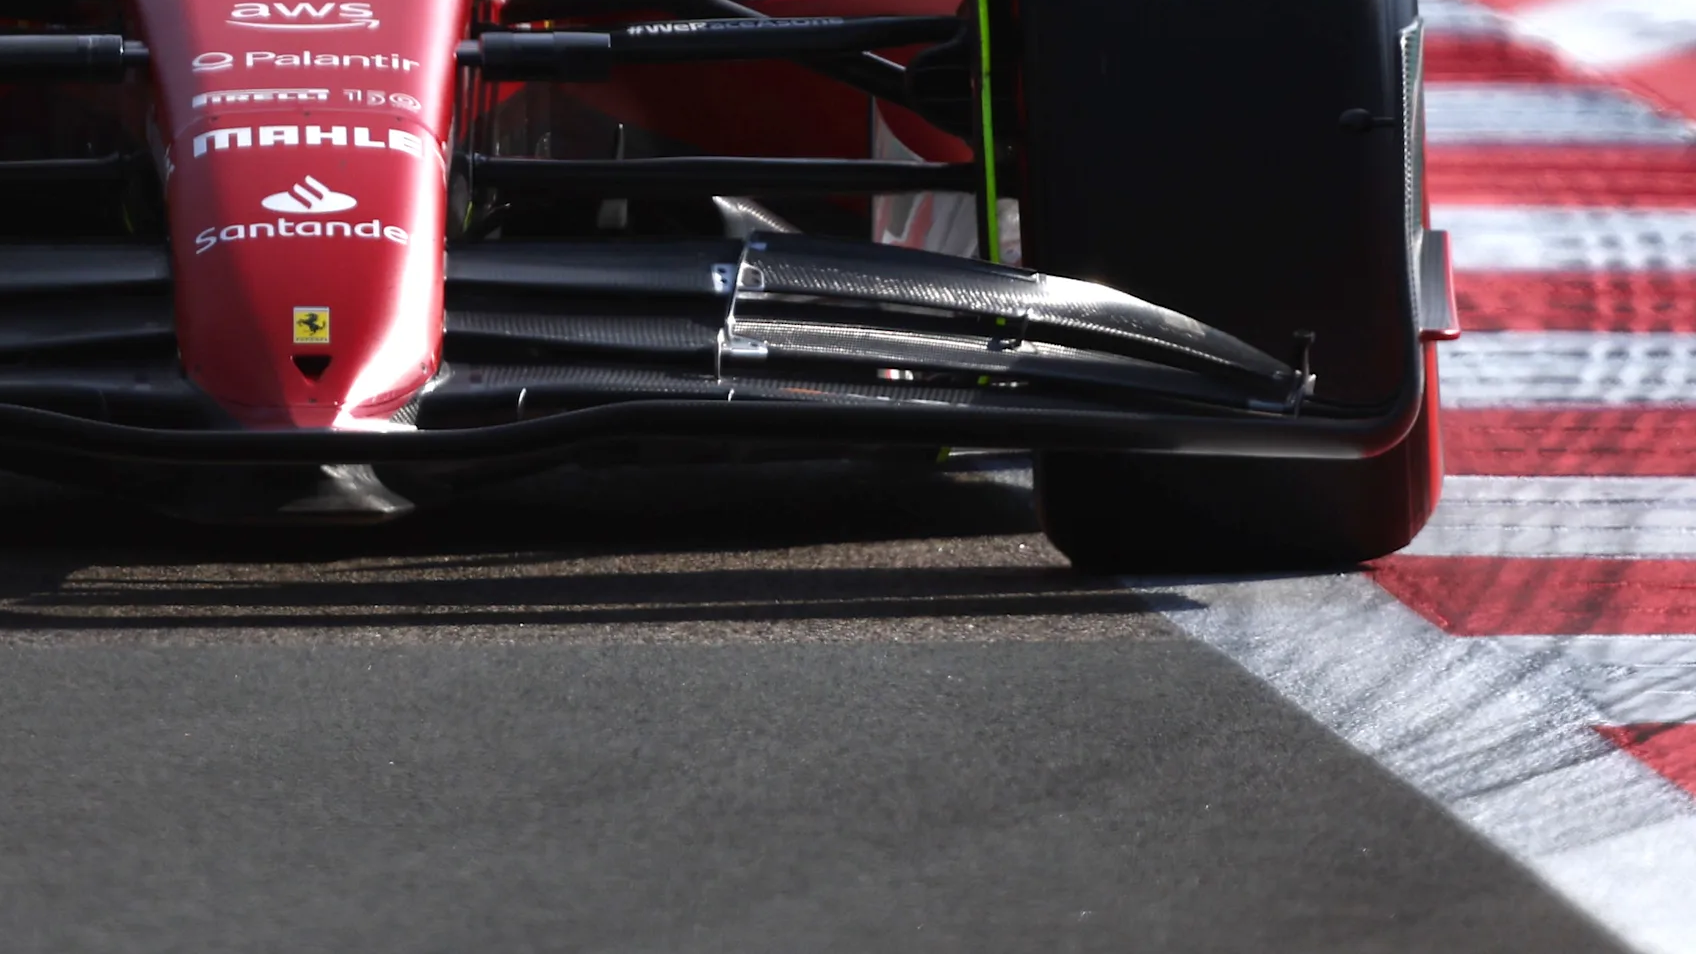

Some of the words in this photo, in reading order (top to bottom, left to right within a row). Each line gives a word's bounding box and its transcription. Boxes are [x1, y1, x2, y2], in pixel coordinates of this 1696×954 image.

[230, 1, 374, 19] aws
[626, 17, 845, 35] #WeRaceAsOne
[244, 50, 420, 72] Palantir
[192, 88, 330, 109] PIRELLI
[193, 125, 422, 159] MAHLE
[195, 217, 410, 255] Santande
